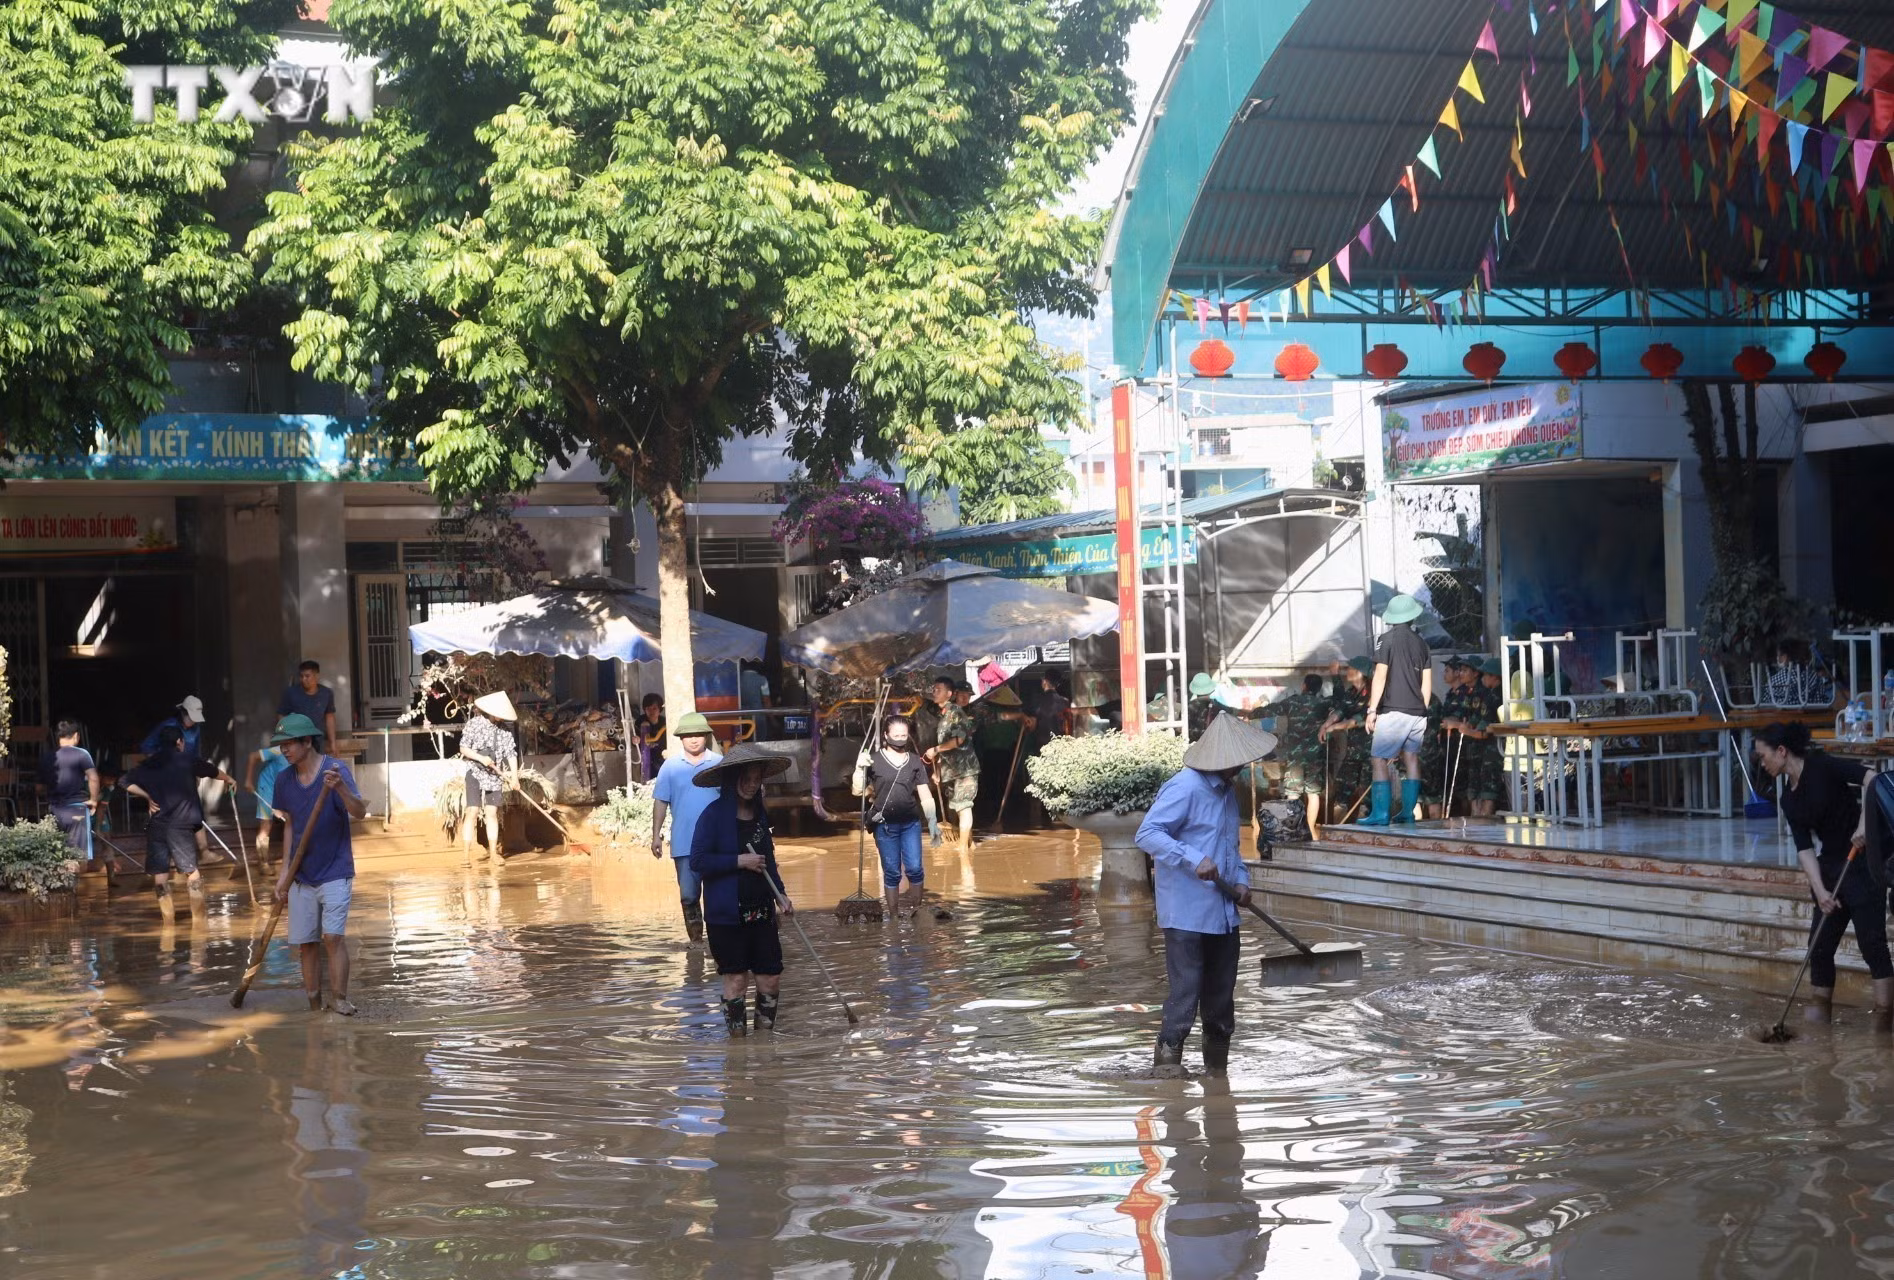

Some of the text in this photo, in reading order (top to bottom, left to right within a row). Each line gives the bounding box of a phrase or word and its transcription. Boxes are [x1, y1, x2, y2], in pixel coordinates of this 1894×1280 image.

[1421, 408, 1451, 432] TRƯỜNG
[1468, 405, 1481, 424] EM
[1502, 401, 1514, 420] EM
[1516, 396, 1532, 417] YÊU
[149, 421, 190, 457] KẾT
[211, 425, 264, 457] KÍNH
[1411, 442, 1426, 460] CHO
[1427, 438, 1447, 460] SẠCH
[1511, 425, 1538, 446] KHÔNG
[1540, 420, 1563, 442] QUÊN
[1, 512, 138, 538] TA LỚN LÊN CÙNG ĐẤT NƯỚC
[1020, 549, 1048, 567] Thân
[1051, 545, 1083, 567] Thiện
[1085, 543, 1110, 564] Của
